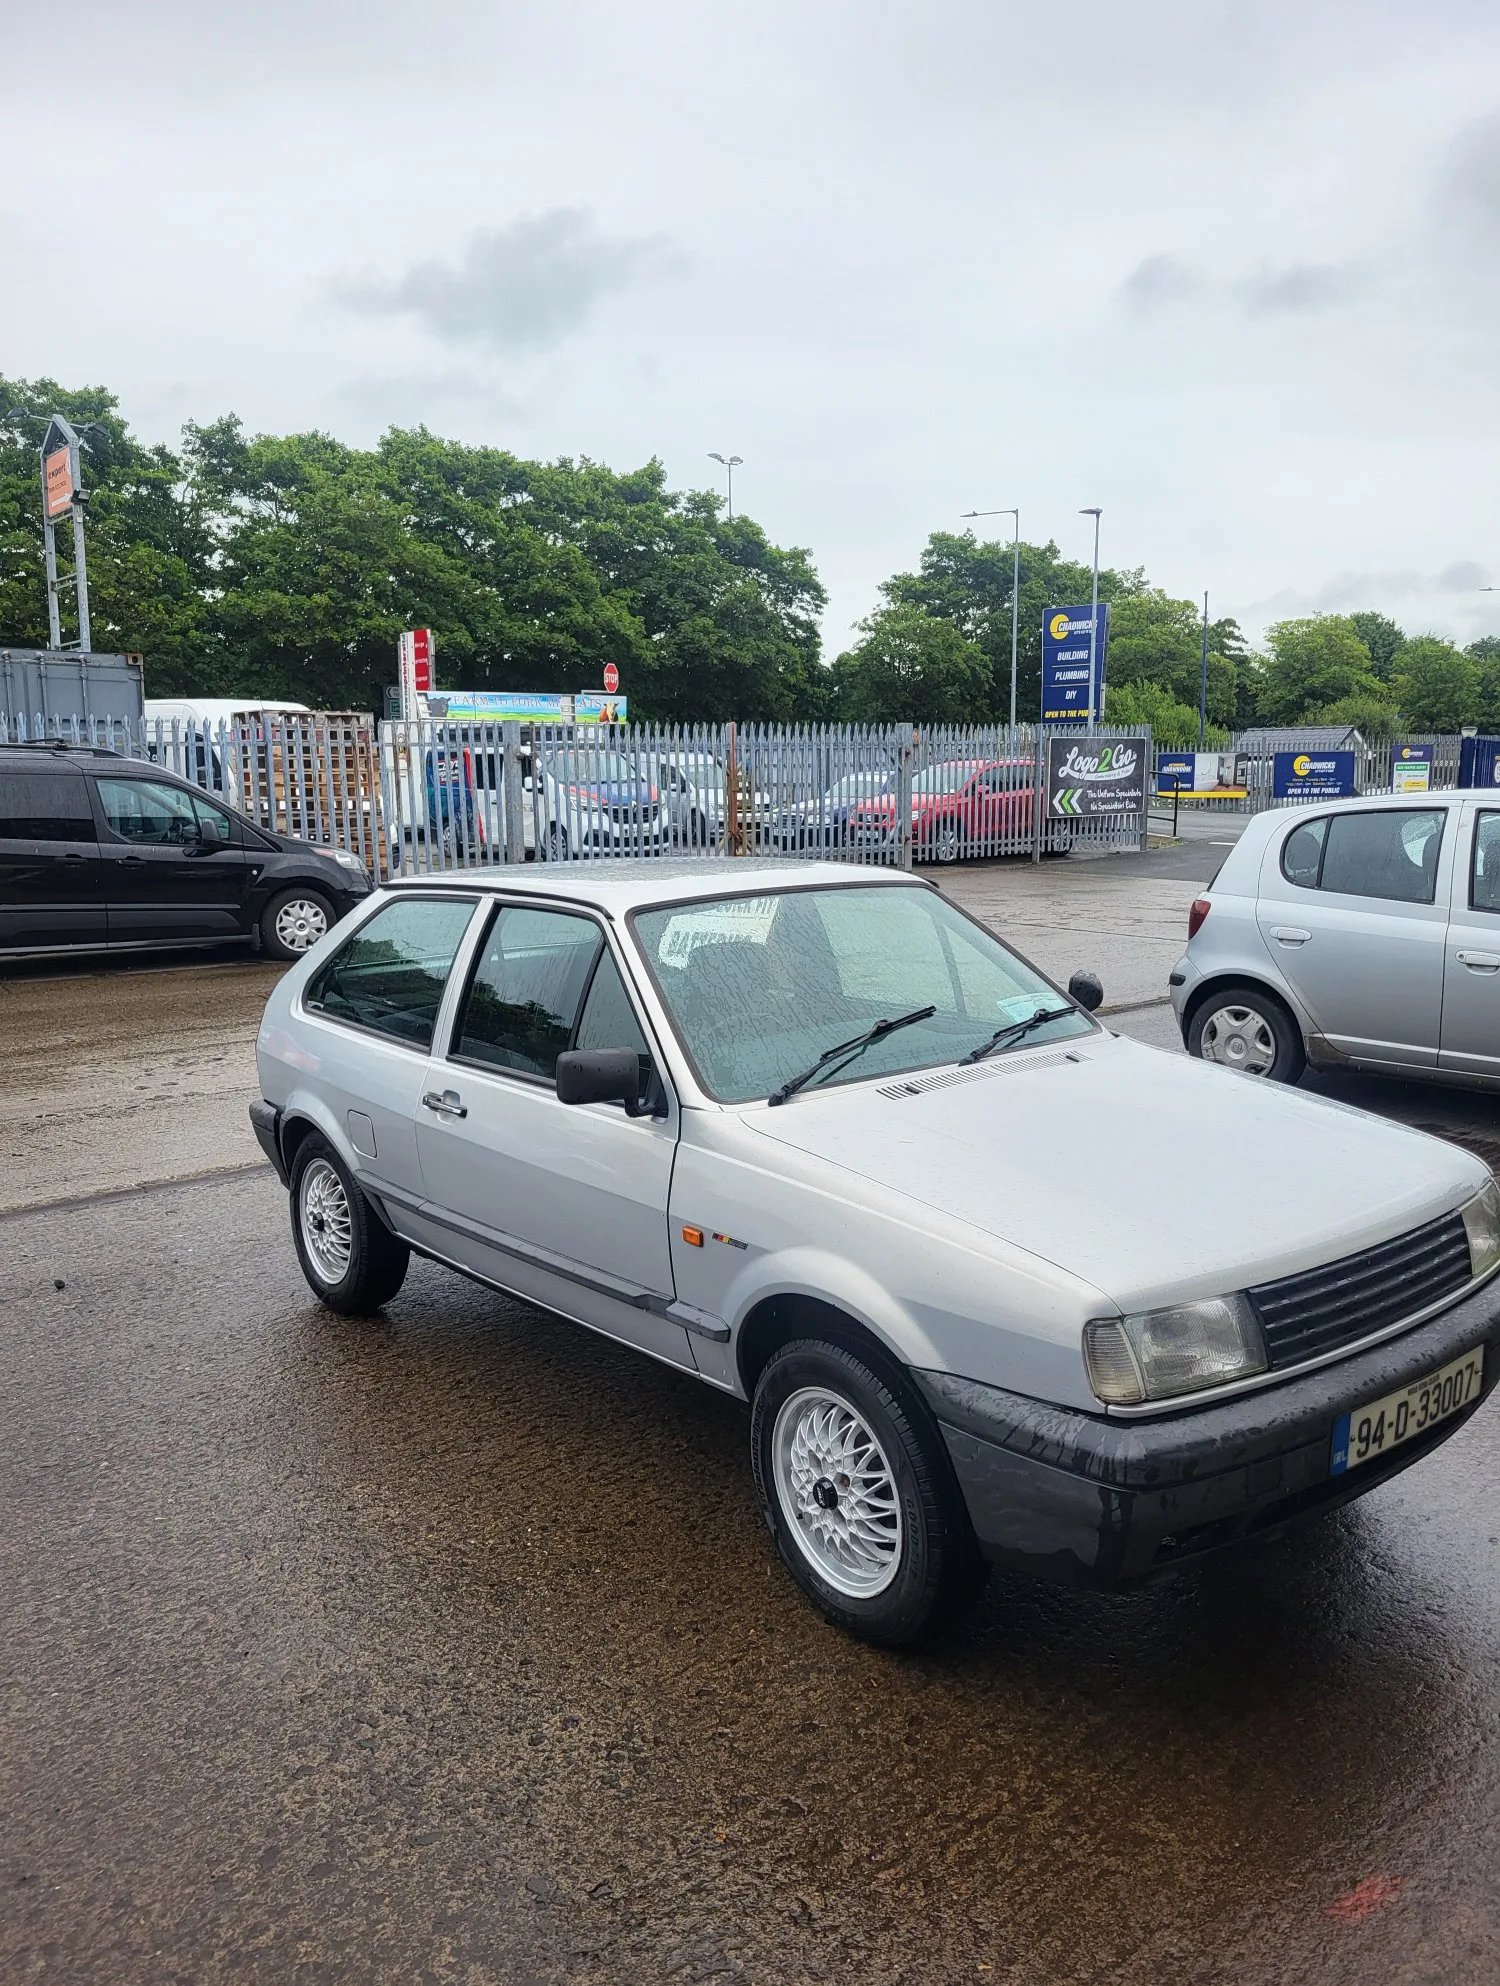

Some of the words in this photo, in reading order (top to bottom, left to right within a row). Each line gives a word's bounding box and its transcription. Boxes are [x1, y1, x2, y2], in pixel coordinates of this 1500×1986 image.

[1057, 650, 1088, 661] BUILDING
[605, 672, 619, 683] STOP
[1055, 670, 1089, 681] PLUMBING
[1065, 690, 1077, 700] DIY
[454, 696, 488, 706] FARM
[495, 697, 508, 706] TO
[512, 697, 541, 707] FORK
[1045, 710, 1058, 718] OPEN
[1060, 710, 1066, 718] TO
[1068, 709, 1077, 717] THE
[1301, 761, 1336, 770] CHADWICKS
[1086, 790, 1097, 798] The
[1116, 787, 1142, 799] Specialists
[1356, 1361, 1475, 1459] 94-D-33007
[1333, 1450, 1347, 1465] IRL
